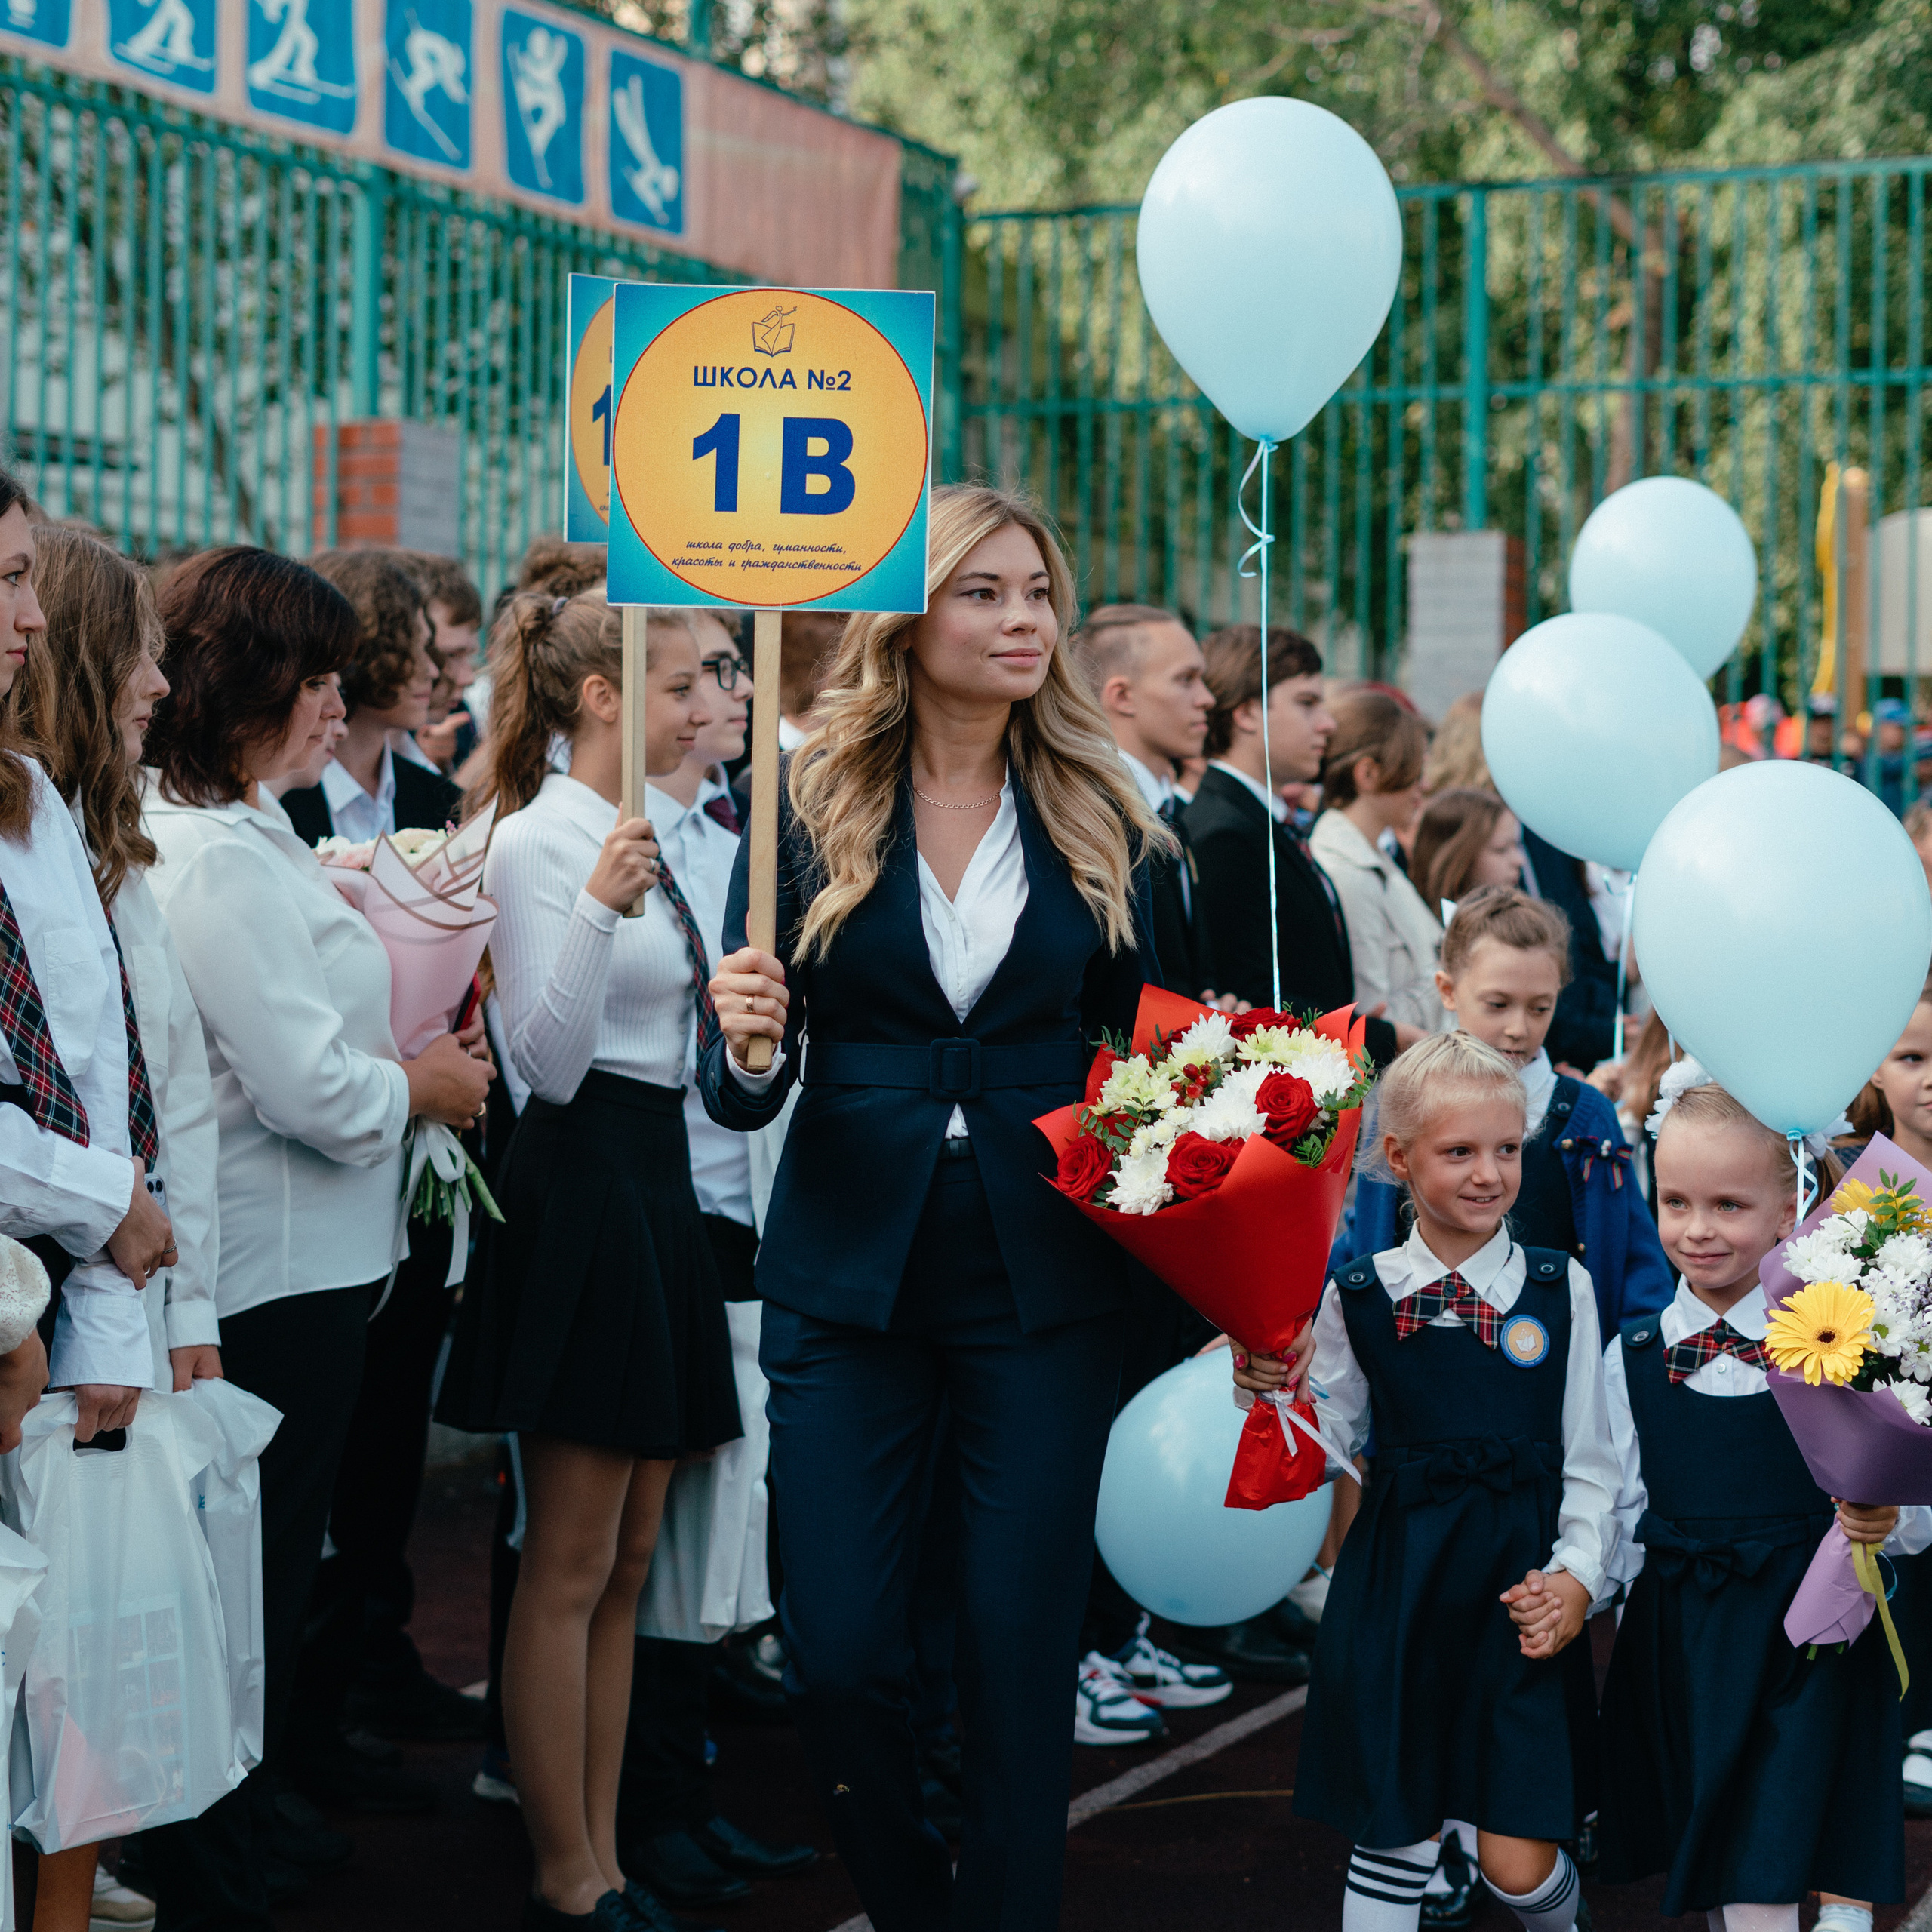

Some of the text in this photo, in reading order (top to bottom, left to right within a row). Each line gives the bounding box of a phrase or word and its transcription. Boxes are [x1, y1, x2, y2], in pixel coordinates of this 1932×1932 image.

[694, 365, 851, 391] ШКОЛА №2
[692, 413, 856, 515] 1 В
[685, 539, 847, 555] школа добра, гуманности,
[672, 557, 723, 569] красоты
[741, 558, 862, 572] гражданственности
